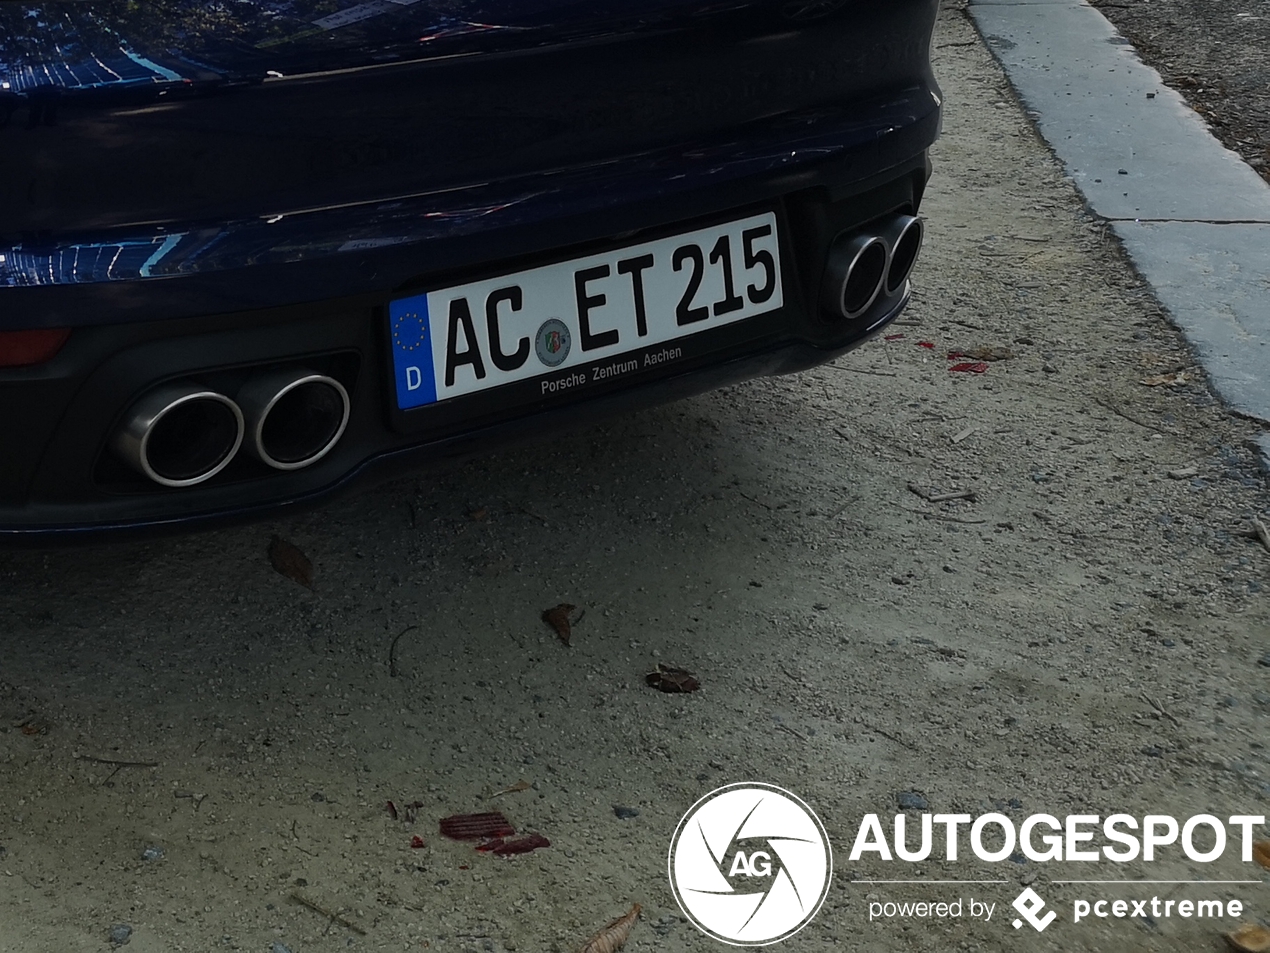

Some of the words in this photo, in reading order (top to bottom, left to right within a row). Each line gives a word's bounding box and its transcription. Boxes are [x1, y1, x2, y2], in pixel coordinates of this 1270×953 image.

[444, 285, 531, 387] AC
[574, 253, 655, 353] ET
[671, 224, 777, 328] 215
[405, 365, 422, 391] D
[540, 371, 586, 395] Porsche
[592, 359, 638, 382] Zentrum
[643, 346, 682, 368] Aachen
